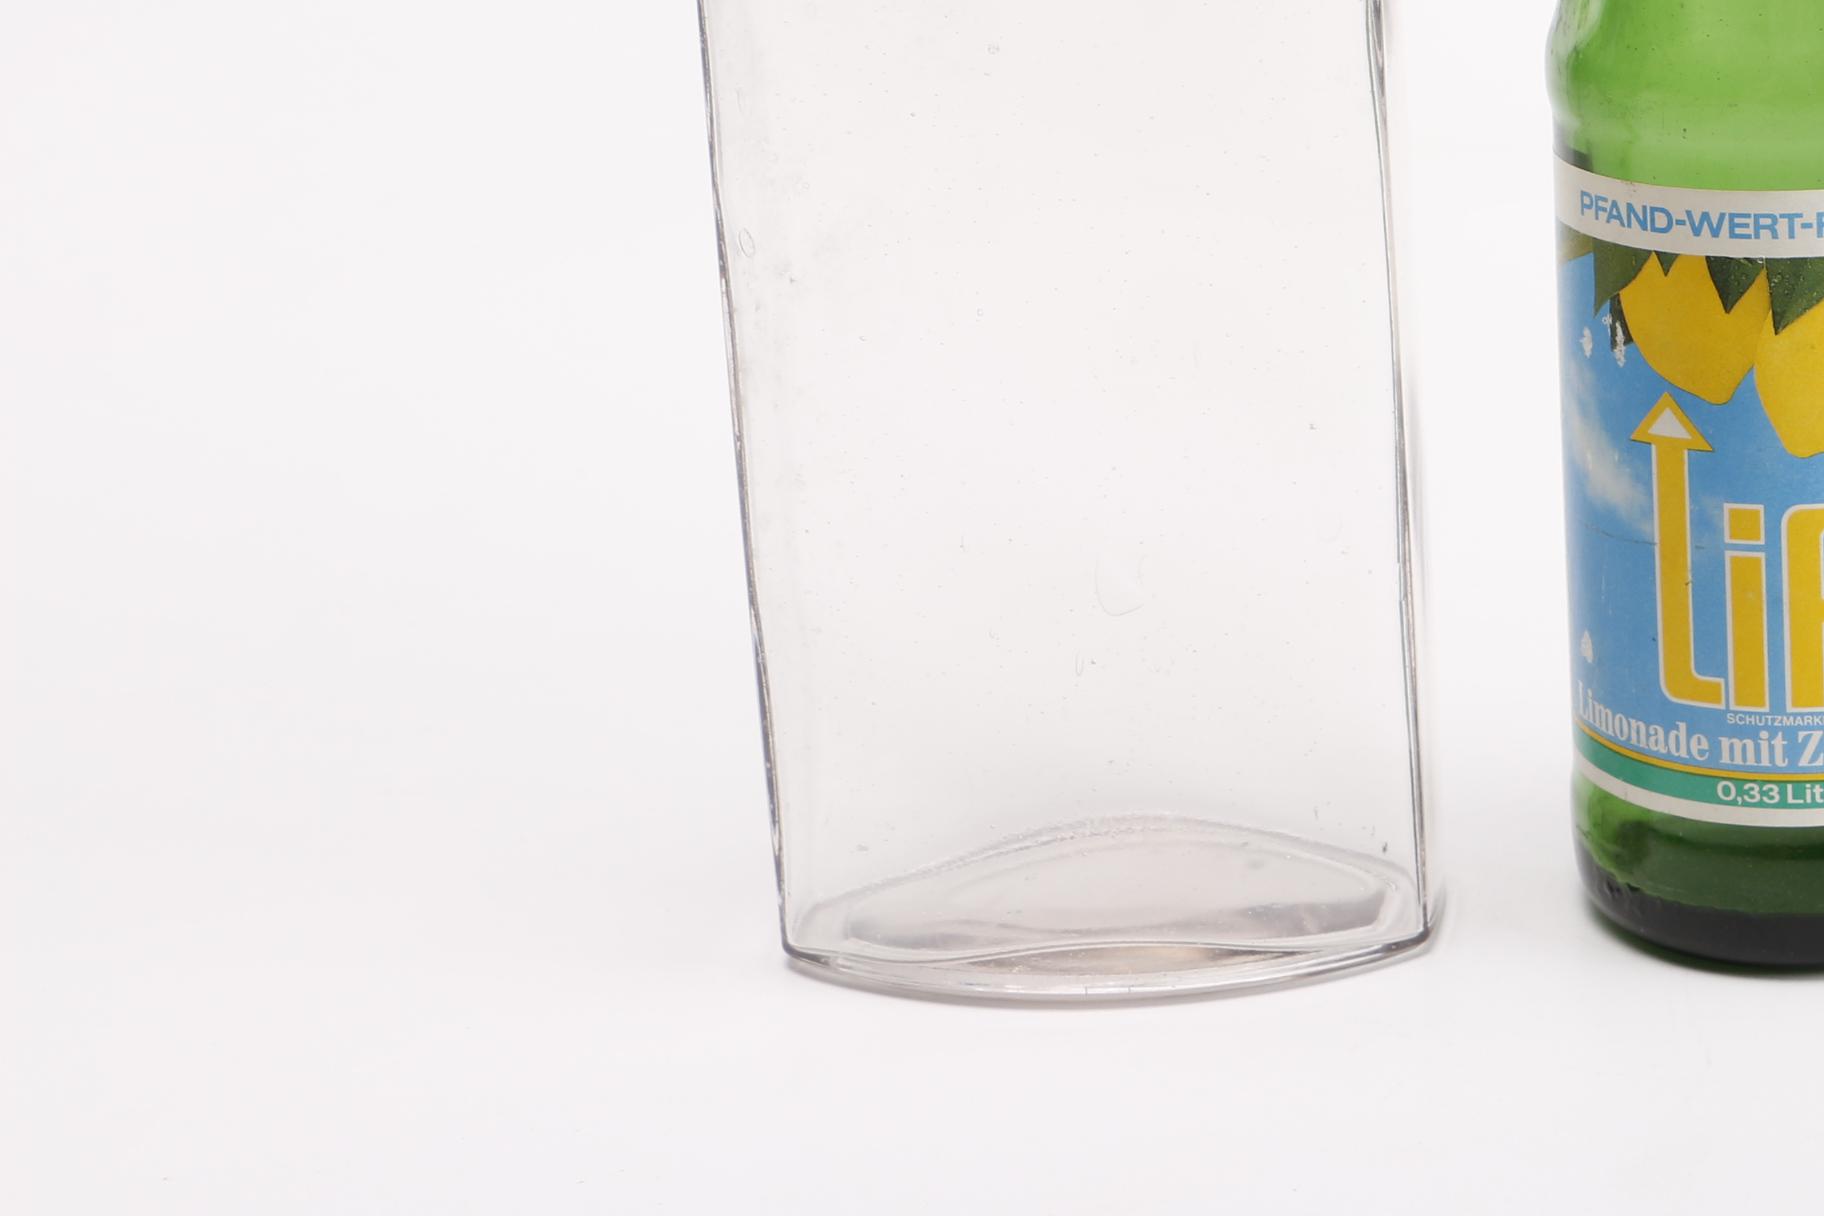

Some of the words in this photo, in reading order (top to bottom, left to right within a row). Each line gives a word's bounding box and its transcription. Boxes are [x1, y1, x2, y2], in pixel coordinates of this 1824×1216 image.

[1575, 680, 1710, 761] Limonade
[1719, 726, 1789, 768] mit
[1716, 782, 1781, 805] 0,33
